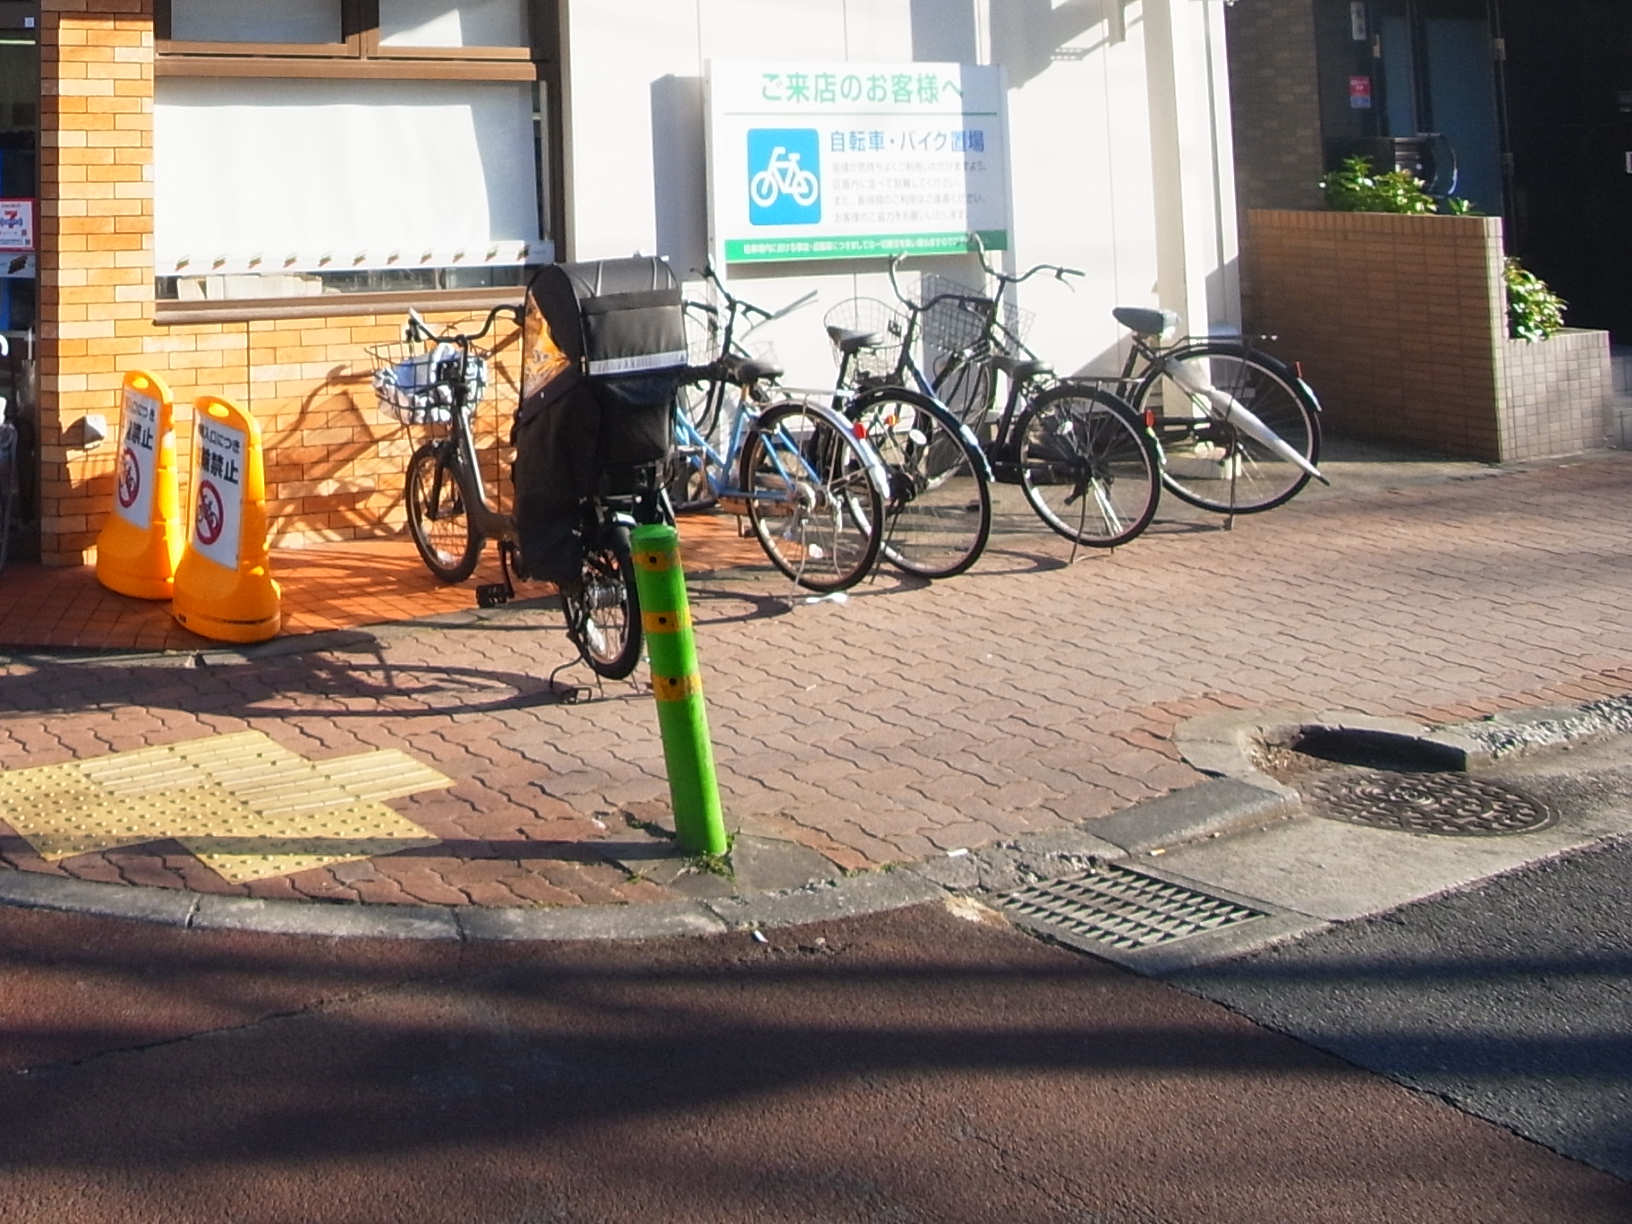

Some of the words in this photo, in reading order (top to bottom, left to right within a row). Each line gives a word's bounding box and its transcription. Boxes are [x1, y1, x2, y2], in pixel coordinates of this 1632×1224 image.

[761, 72, 964, 104] ご来店のお客様へ
[830, 130, 985, 153] 自転車・バイク置場
